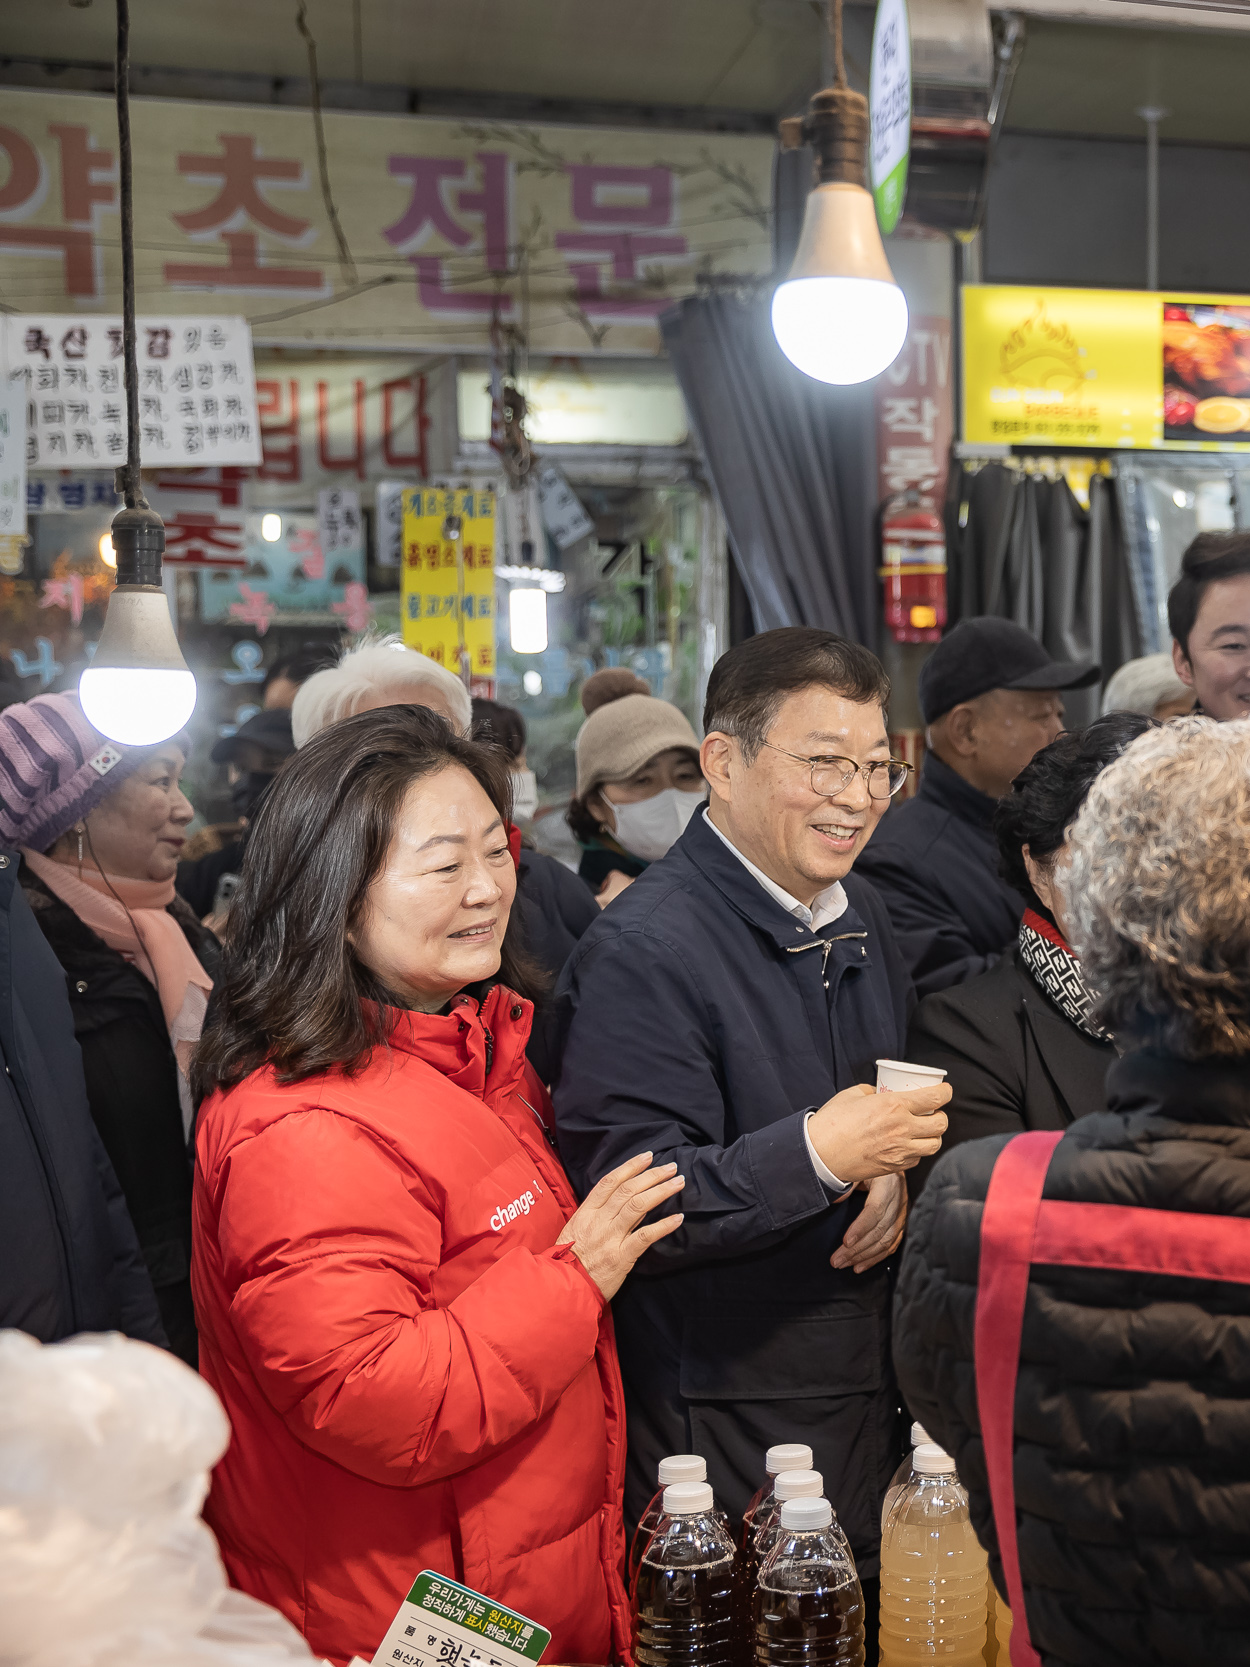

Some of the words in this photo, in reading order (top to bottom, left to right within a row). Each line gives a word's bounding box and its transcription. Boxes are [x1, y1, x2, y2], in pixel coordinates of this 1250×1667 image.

[382, 152, 688, 318] 전문
[490, 1190, 536, 1232] change
[422, 1593, 465, 1623] 정직하게
[464, 1613, 528, 1652] 표시했습니다
[428, 1582, 486, 1617] 우리가게는
[488, 1609, 535, 1640] 원산지를
[392, 1649, 425, 1667] 원산지
[427, 1634, 438, 1646] 명
